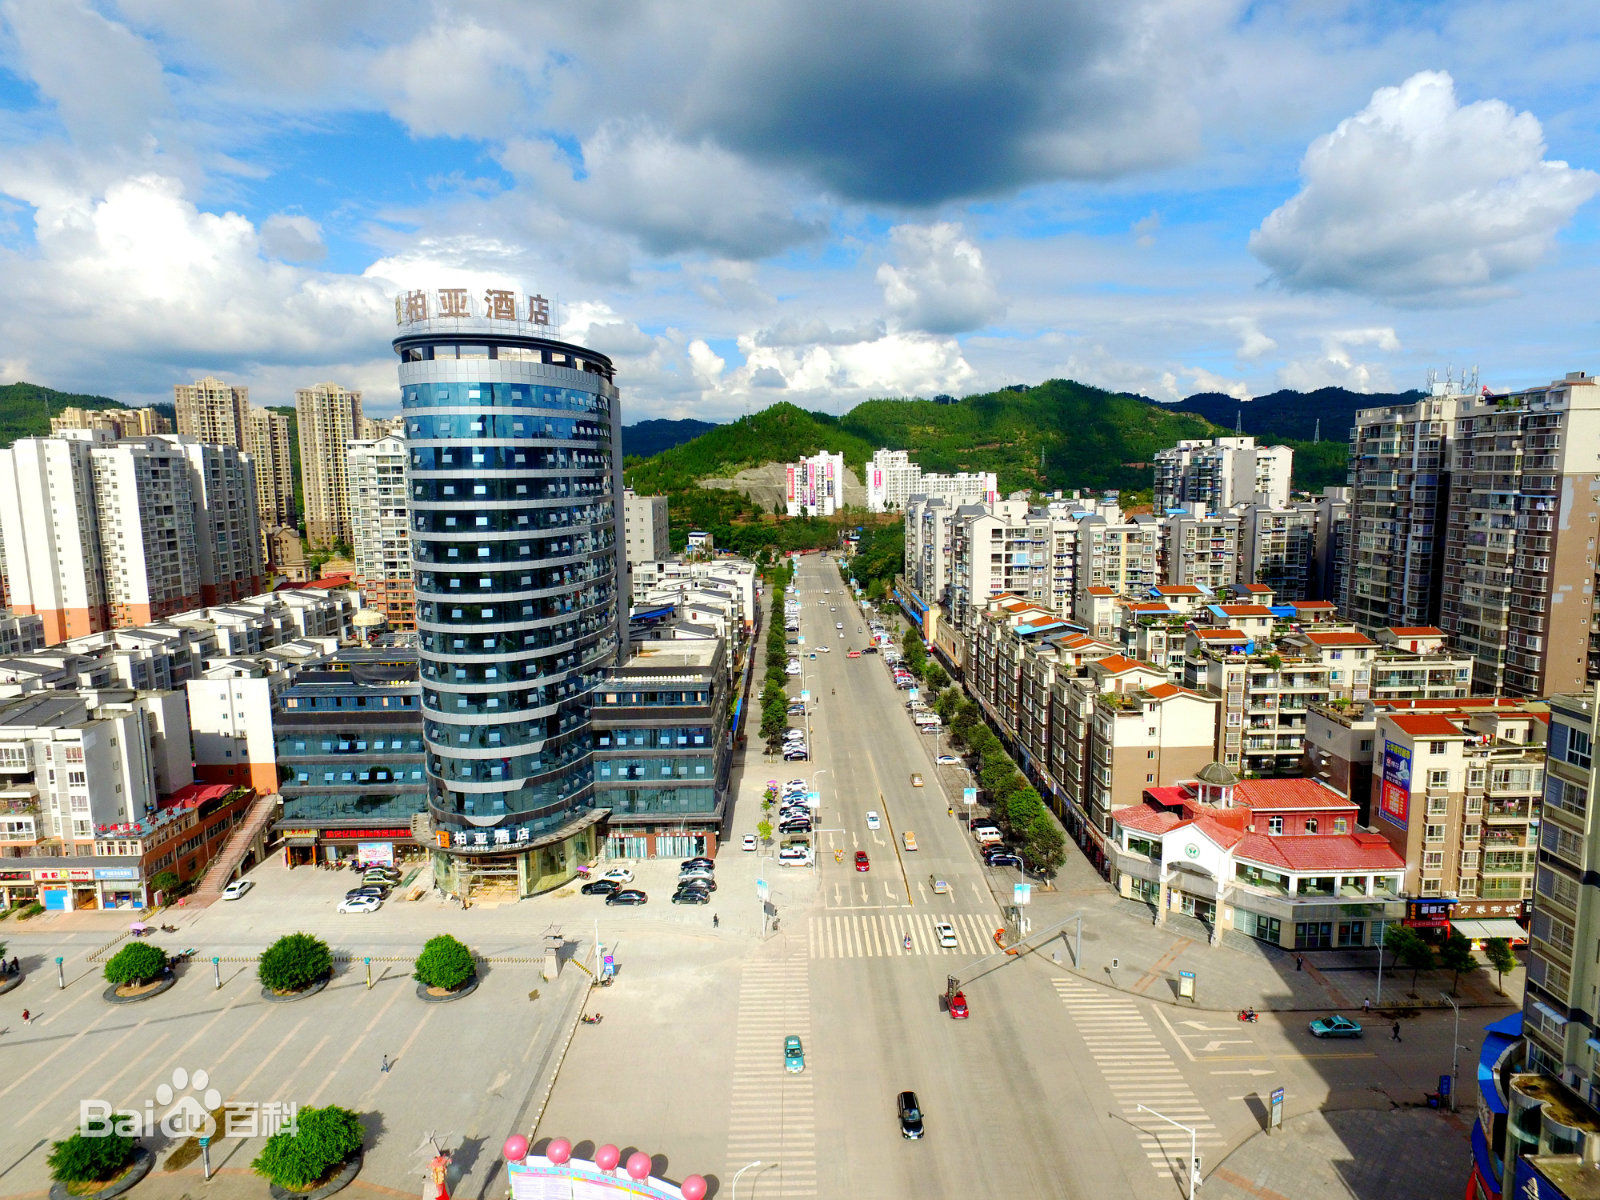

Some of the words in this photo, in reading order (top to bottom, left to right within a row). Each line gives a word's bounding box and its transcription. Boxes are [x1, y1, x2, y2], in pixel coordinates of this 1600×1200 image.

[405, 288, 551, 325] 柏亚酒店
[454, 827, 530, 845] 柏亚酒店
